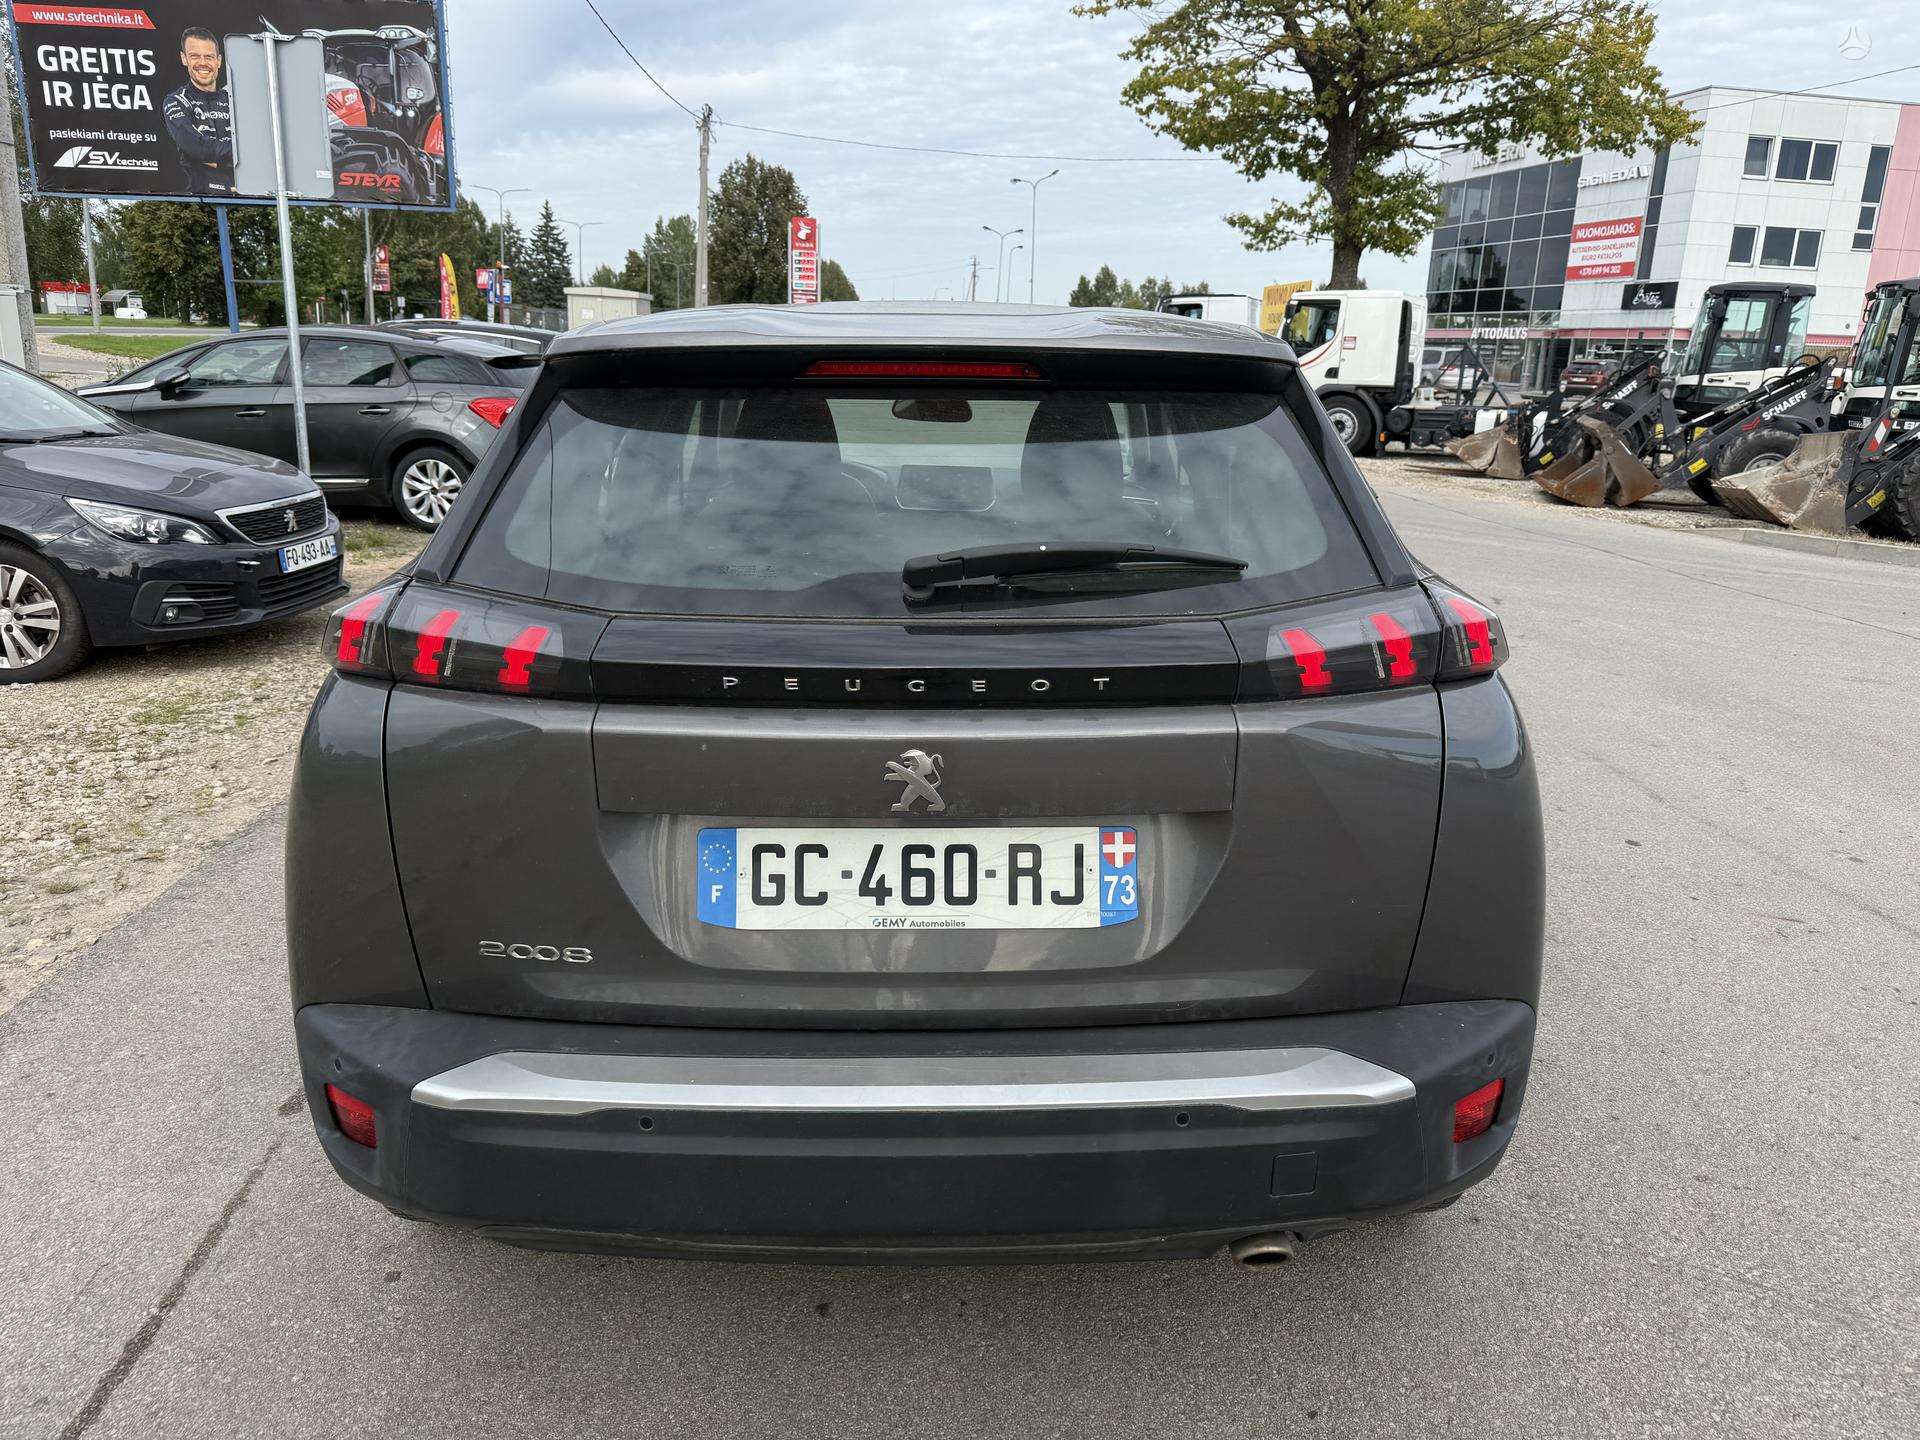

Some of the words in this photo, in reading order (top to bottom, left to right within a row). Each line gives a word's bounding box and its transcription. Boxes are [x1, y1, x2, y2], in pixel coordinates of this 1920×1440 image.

[31, 10, 143, 25] www.svtechnika.lt
[37, 44, 156, 76] GREITIS
[42, 80, 74, 107] IR
[82, 75, 154, 111] JĖGA
[49, 128, 105, 140] pasiekiami
[107, 130, 142, 143] drauge
[145, 133, 157, 142] su
[338, 172, 400, 187] STEYR
[1576, 222, 1636, 239] NUOMOJAMOS:
[1470, 326, 1529, 340] AUTODALYS
[1762, 389, 1808, 421] SCHAEFF
[722, 676, 1110, 693] PEUGEOT
[750, 843, 1085, 907] GC-460-RJ
[711, 884, 723, 903] F
[1103, 874, 1136, 905] 73
[872, 918, 907, 928] GEMY
[909, 919, 966, 928] Automobiles
[479, 940, 594, 963] 2008
